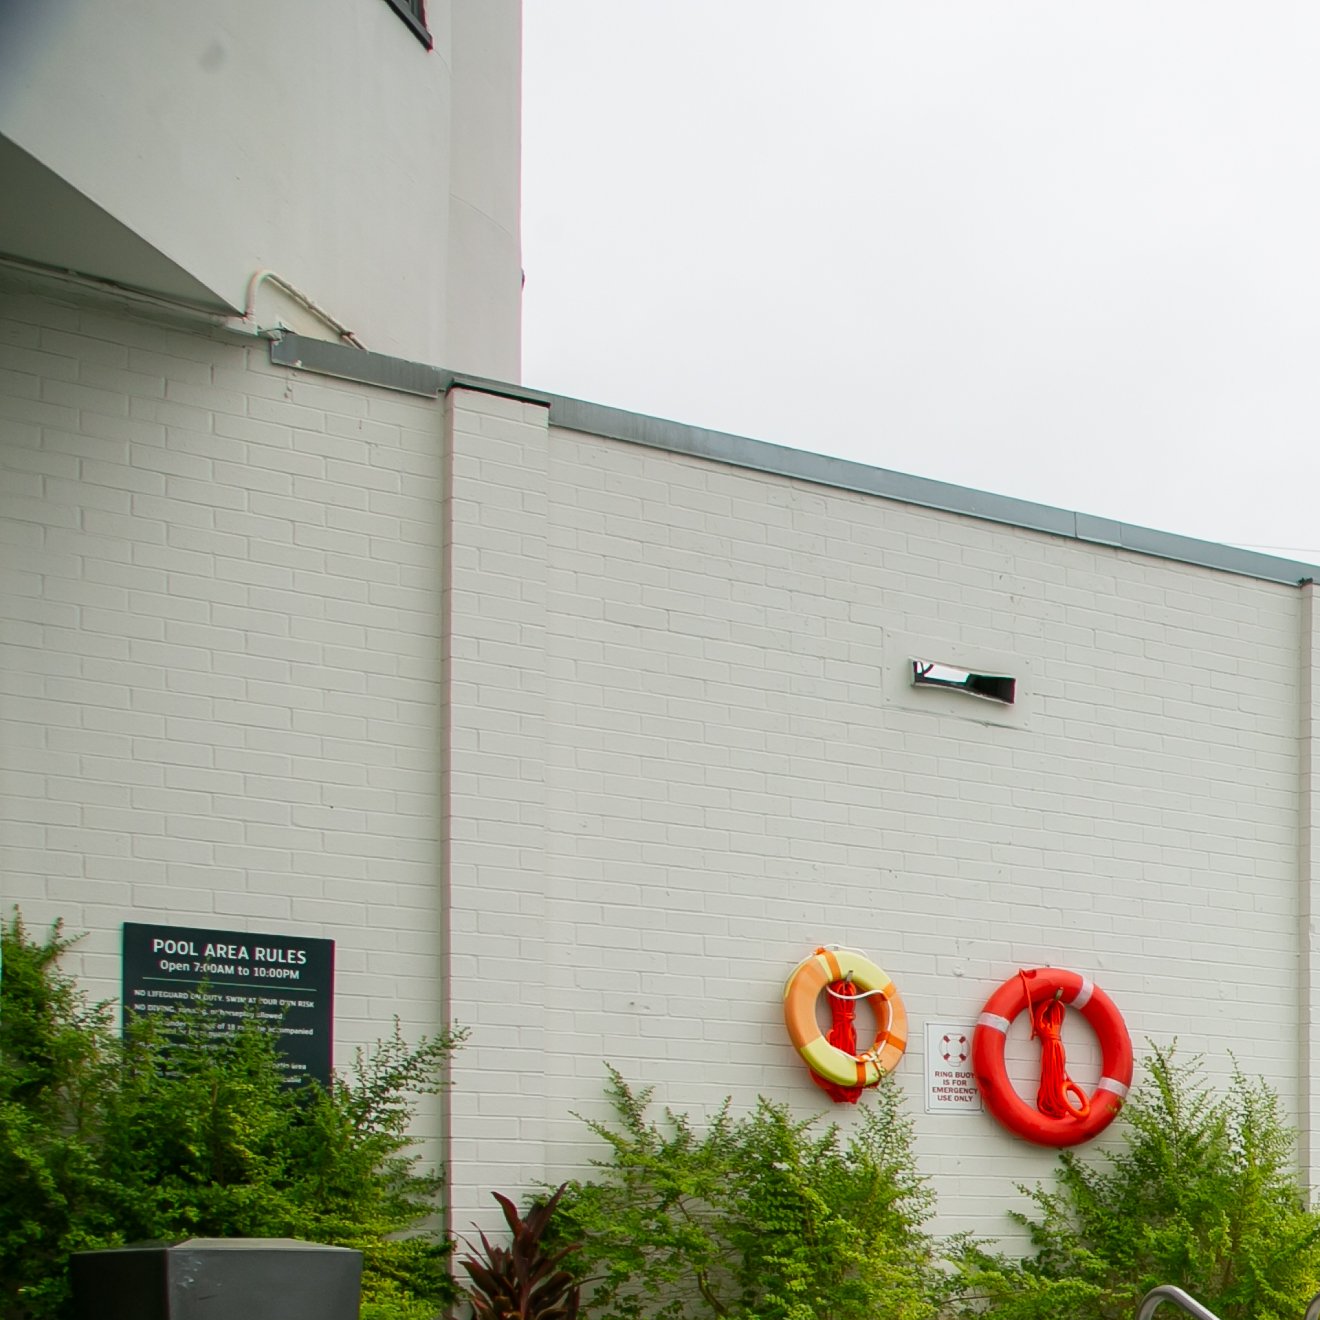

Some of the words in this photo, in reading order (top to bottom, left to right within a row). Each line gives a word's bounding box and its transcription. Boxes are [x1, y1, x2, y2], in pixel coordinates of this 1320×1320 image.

[153, 938, 199, 956] POOL
[204, 943, 250, 960] AREA
[254, 946, 307, 965] RULES
[160, 959, 190, 973] Open
[237, 965, 250, 976] to
[253, 967, 300, 980] 10:00PM
[134, 989, 146, 997] NO
[147, 990, 189, 1000] LIFEGUARD
[258, 998, 278, 1006] OUR
[297, 1000, 315, 1008] RISK
[134, 1003, 146, 1011] NO
[932, 1087, 977, 1095] EMERGENCY
